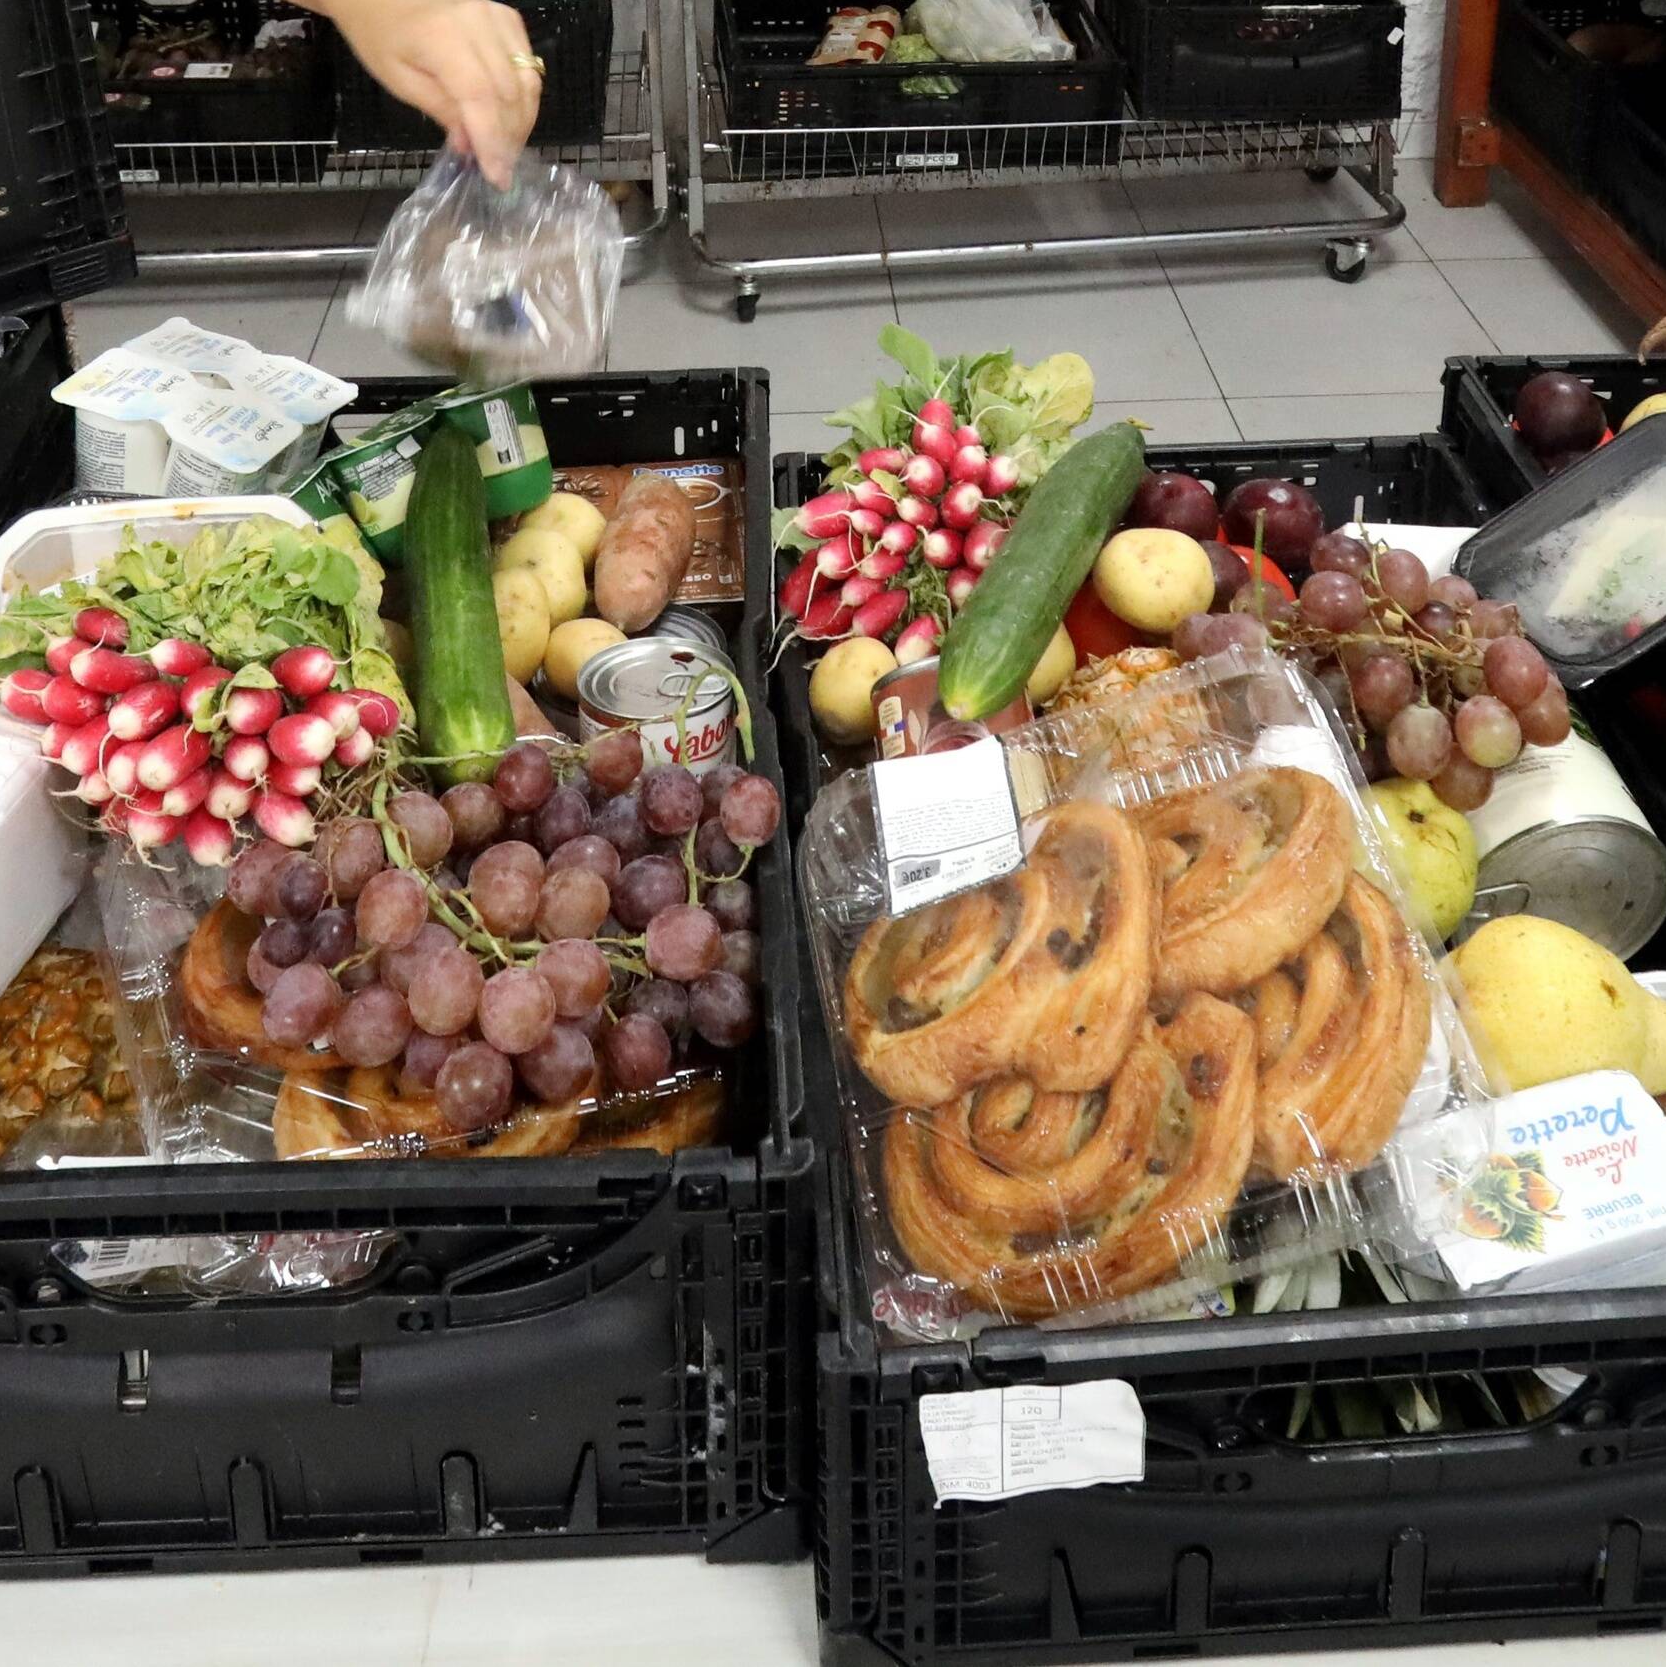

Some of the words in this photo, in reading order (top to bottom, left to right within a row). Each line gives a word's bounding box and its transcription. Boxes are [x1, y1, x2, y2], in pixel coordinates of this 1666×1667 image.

[1563, 1135, 1639, 1168] Noisette
[1597, 1157, 1624, 1185] La
[1581, 1192, 1645, 1221] BEURRE
